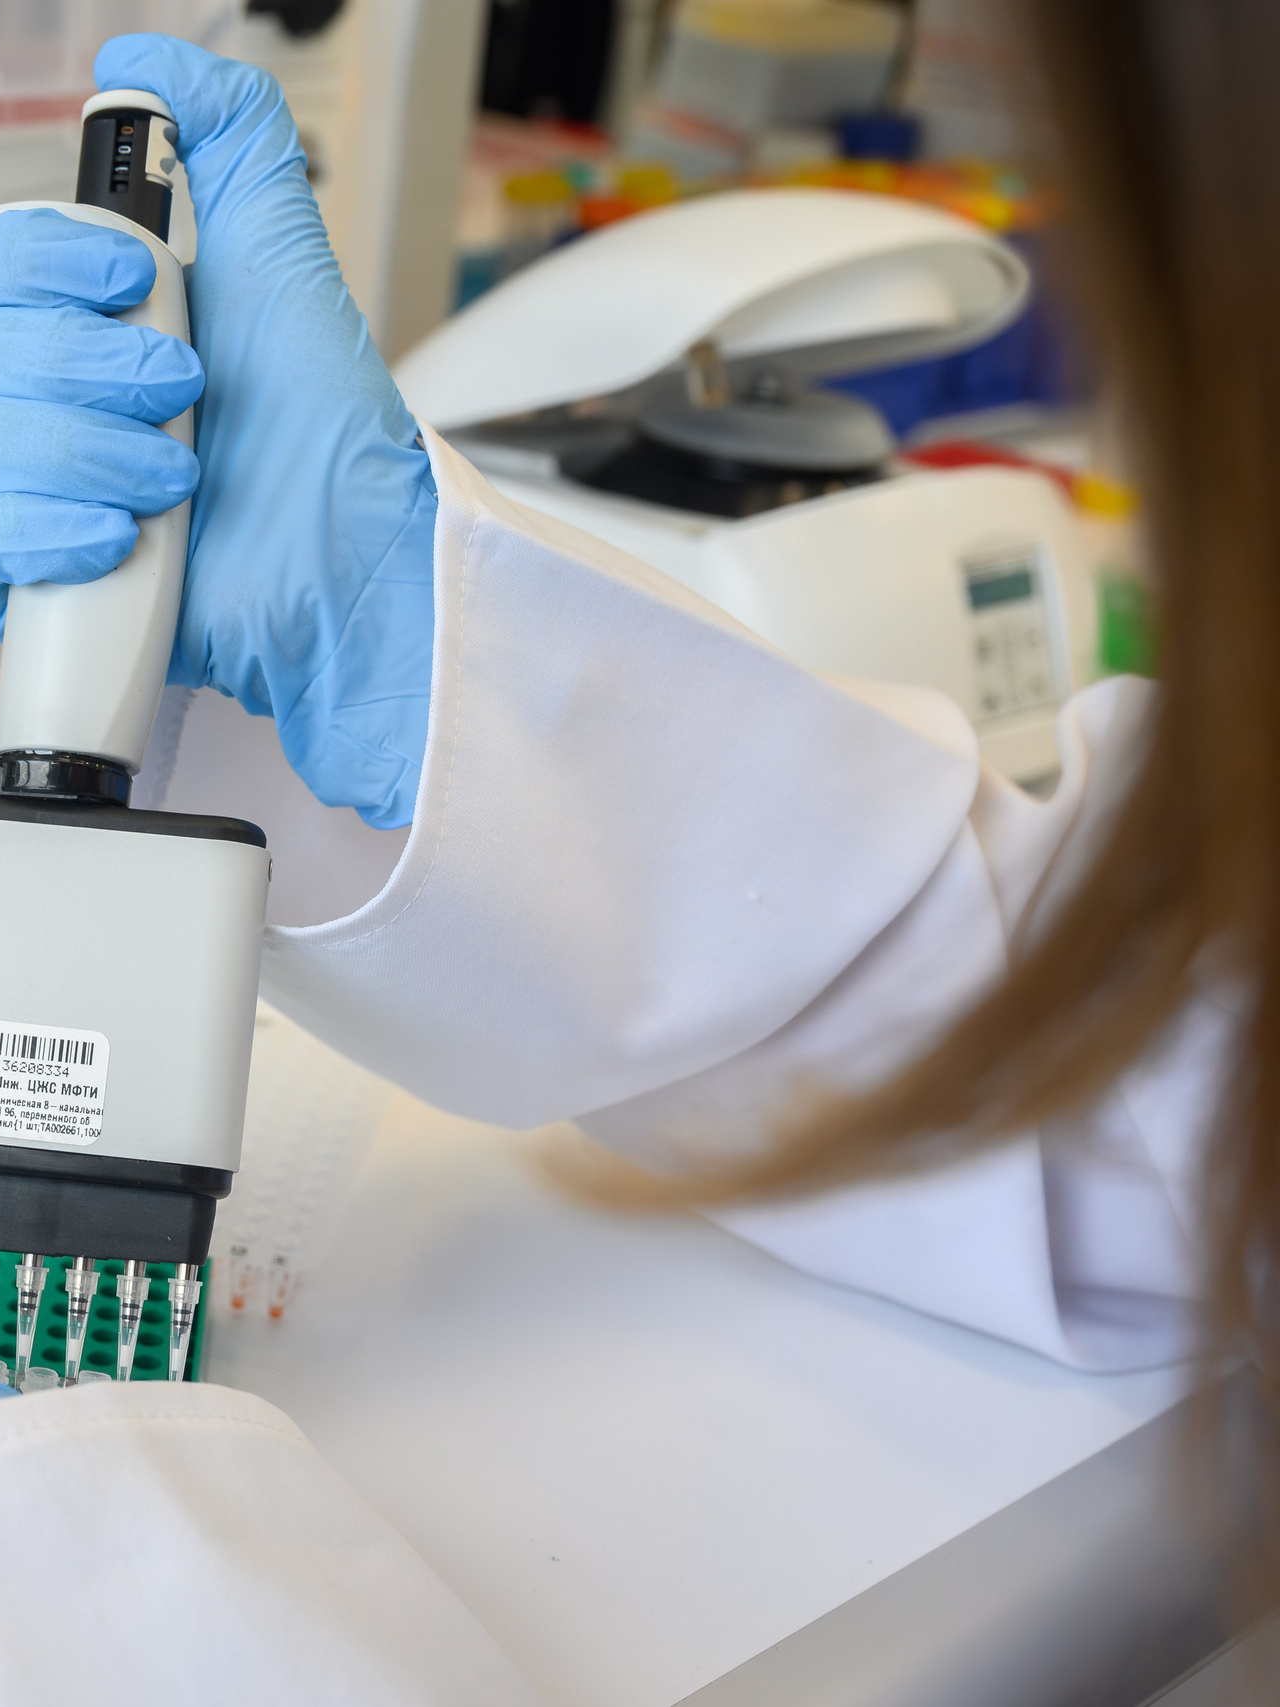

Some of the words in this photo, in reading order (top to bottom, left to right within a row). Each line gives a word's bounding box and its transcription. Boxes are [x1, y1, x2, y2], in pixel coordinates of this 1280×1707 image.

[27, 1079, 57, 1094] ЦЖС
[61, 1083, 98, 1099] МФТИ
[4, 1107, 17, 1119] 96,
[20, 1110, 77, 1124] переменного
[80, 1116, 91, 1126] об
